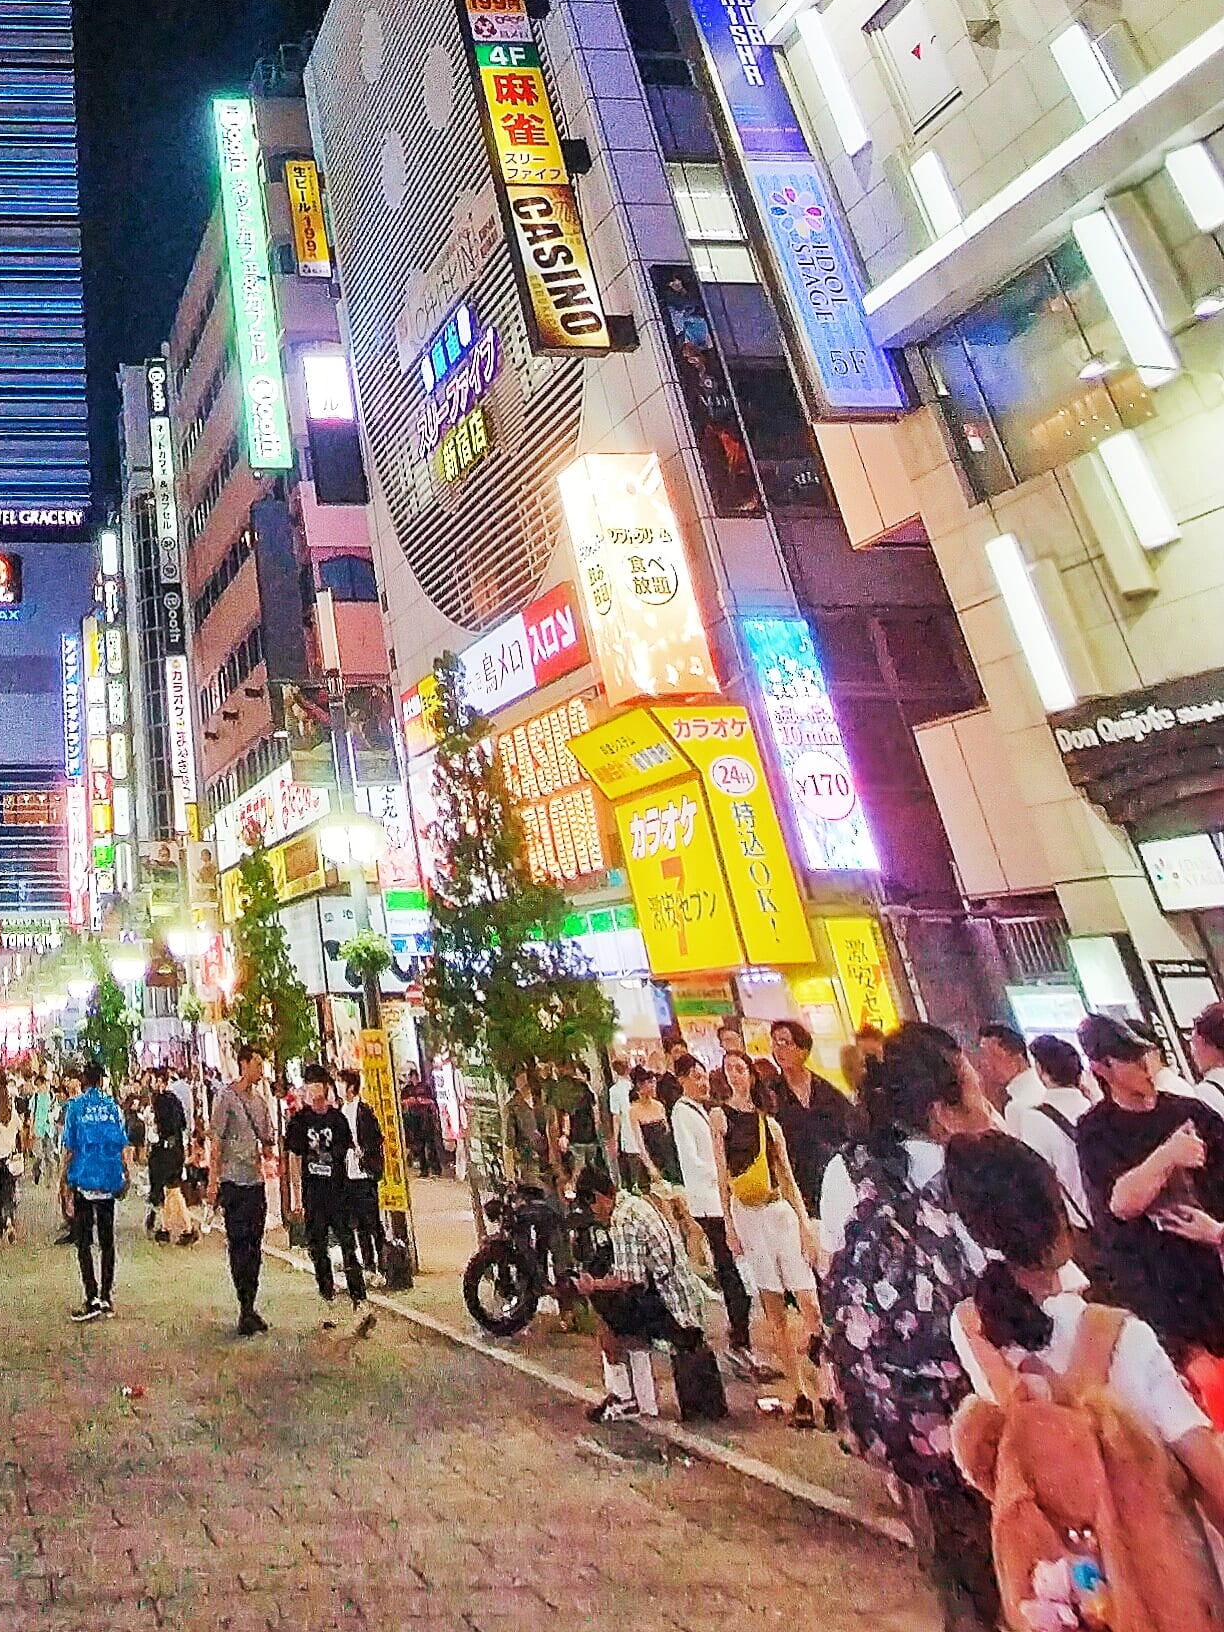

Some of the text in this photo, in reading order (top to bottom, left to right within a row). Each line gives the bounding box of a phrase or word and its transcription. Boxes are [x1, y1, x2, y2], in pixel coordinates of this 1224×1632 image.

[488, 46, 527, 67] 4F
[492, 73, 550, 147] 麻雀
[504, 152, 546, 165] スリー
[292, 166, 312, 213] 生ビール
[512, 196, 603, 336] CASINO
[812, 245, 848, 306] IDOL
[791, 243, 834, 322] STAGE
[830, 349, 867, 375] 5F
[18, 508, 84, 526] GRACERY
[627, 555, 665, 574] 食べ
[672, 717, 749, 739] カラオケ
[1054, 727, 1102, 754] Don
[717, 764, 752, 785] 24H
[795, 772, 850, 797] ¥170
[629, 794, 698, 861] カラオケ
